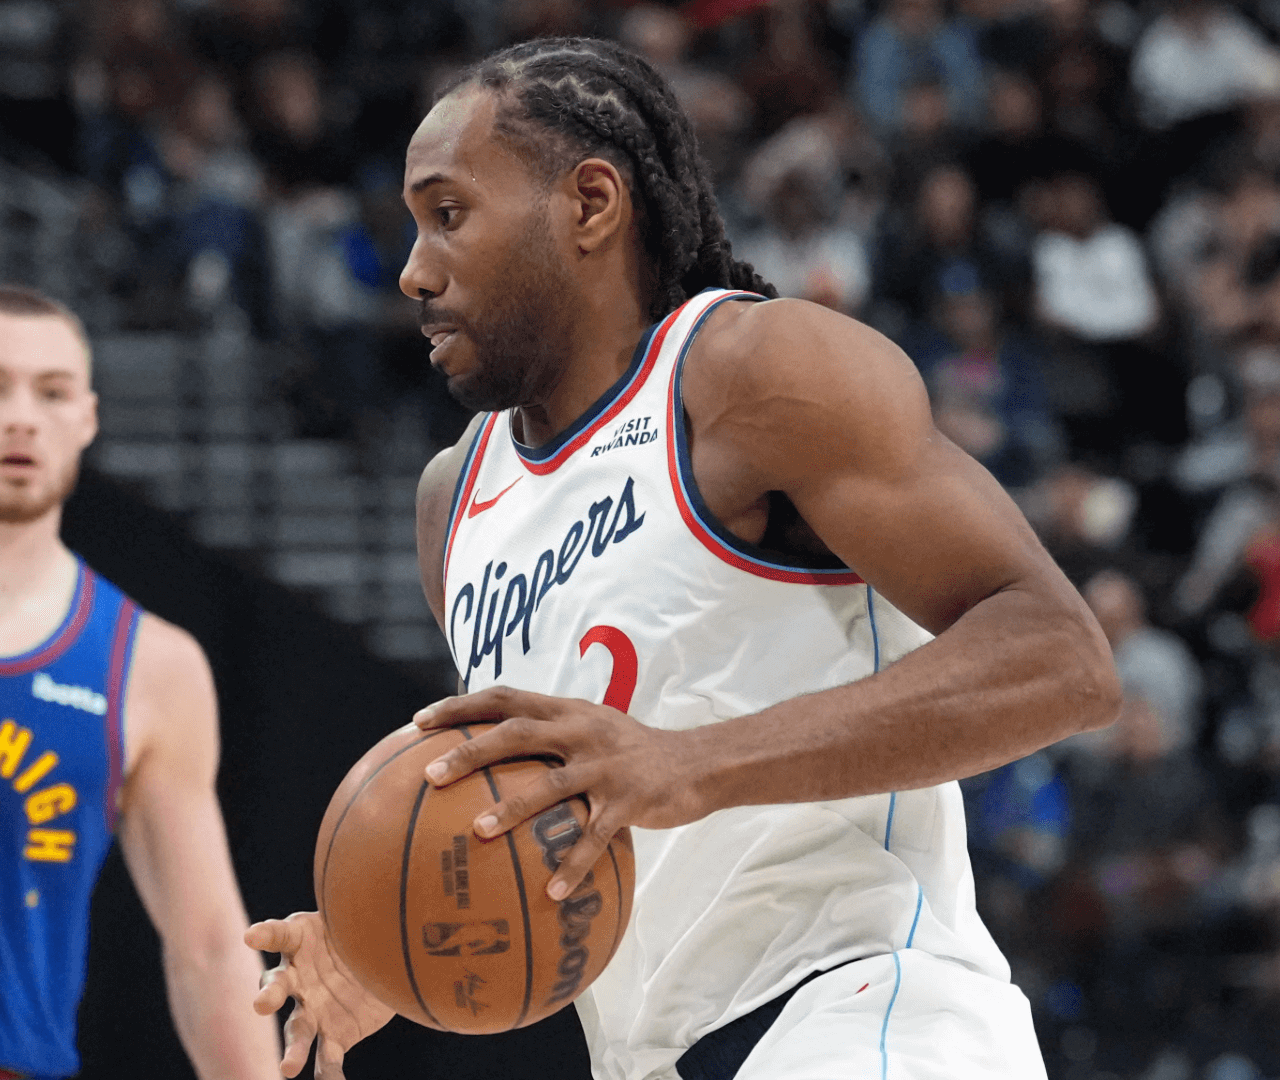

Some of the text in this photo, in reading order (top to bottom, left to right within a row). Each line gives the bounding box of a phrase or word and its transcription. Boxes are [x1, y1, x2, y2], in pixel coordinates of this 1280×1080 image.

[613, 415, 652, 438] VISIT
[590, 428, 658, 458] RWANDA
[450, 475, 647, 694] Clippers
